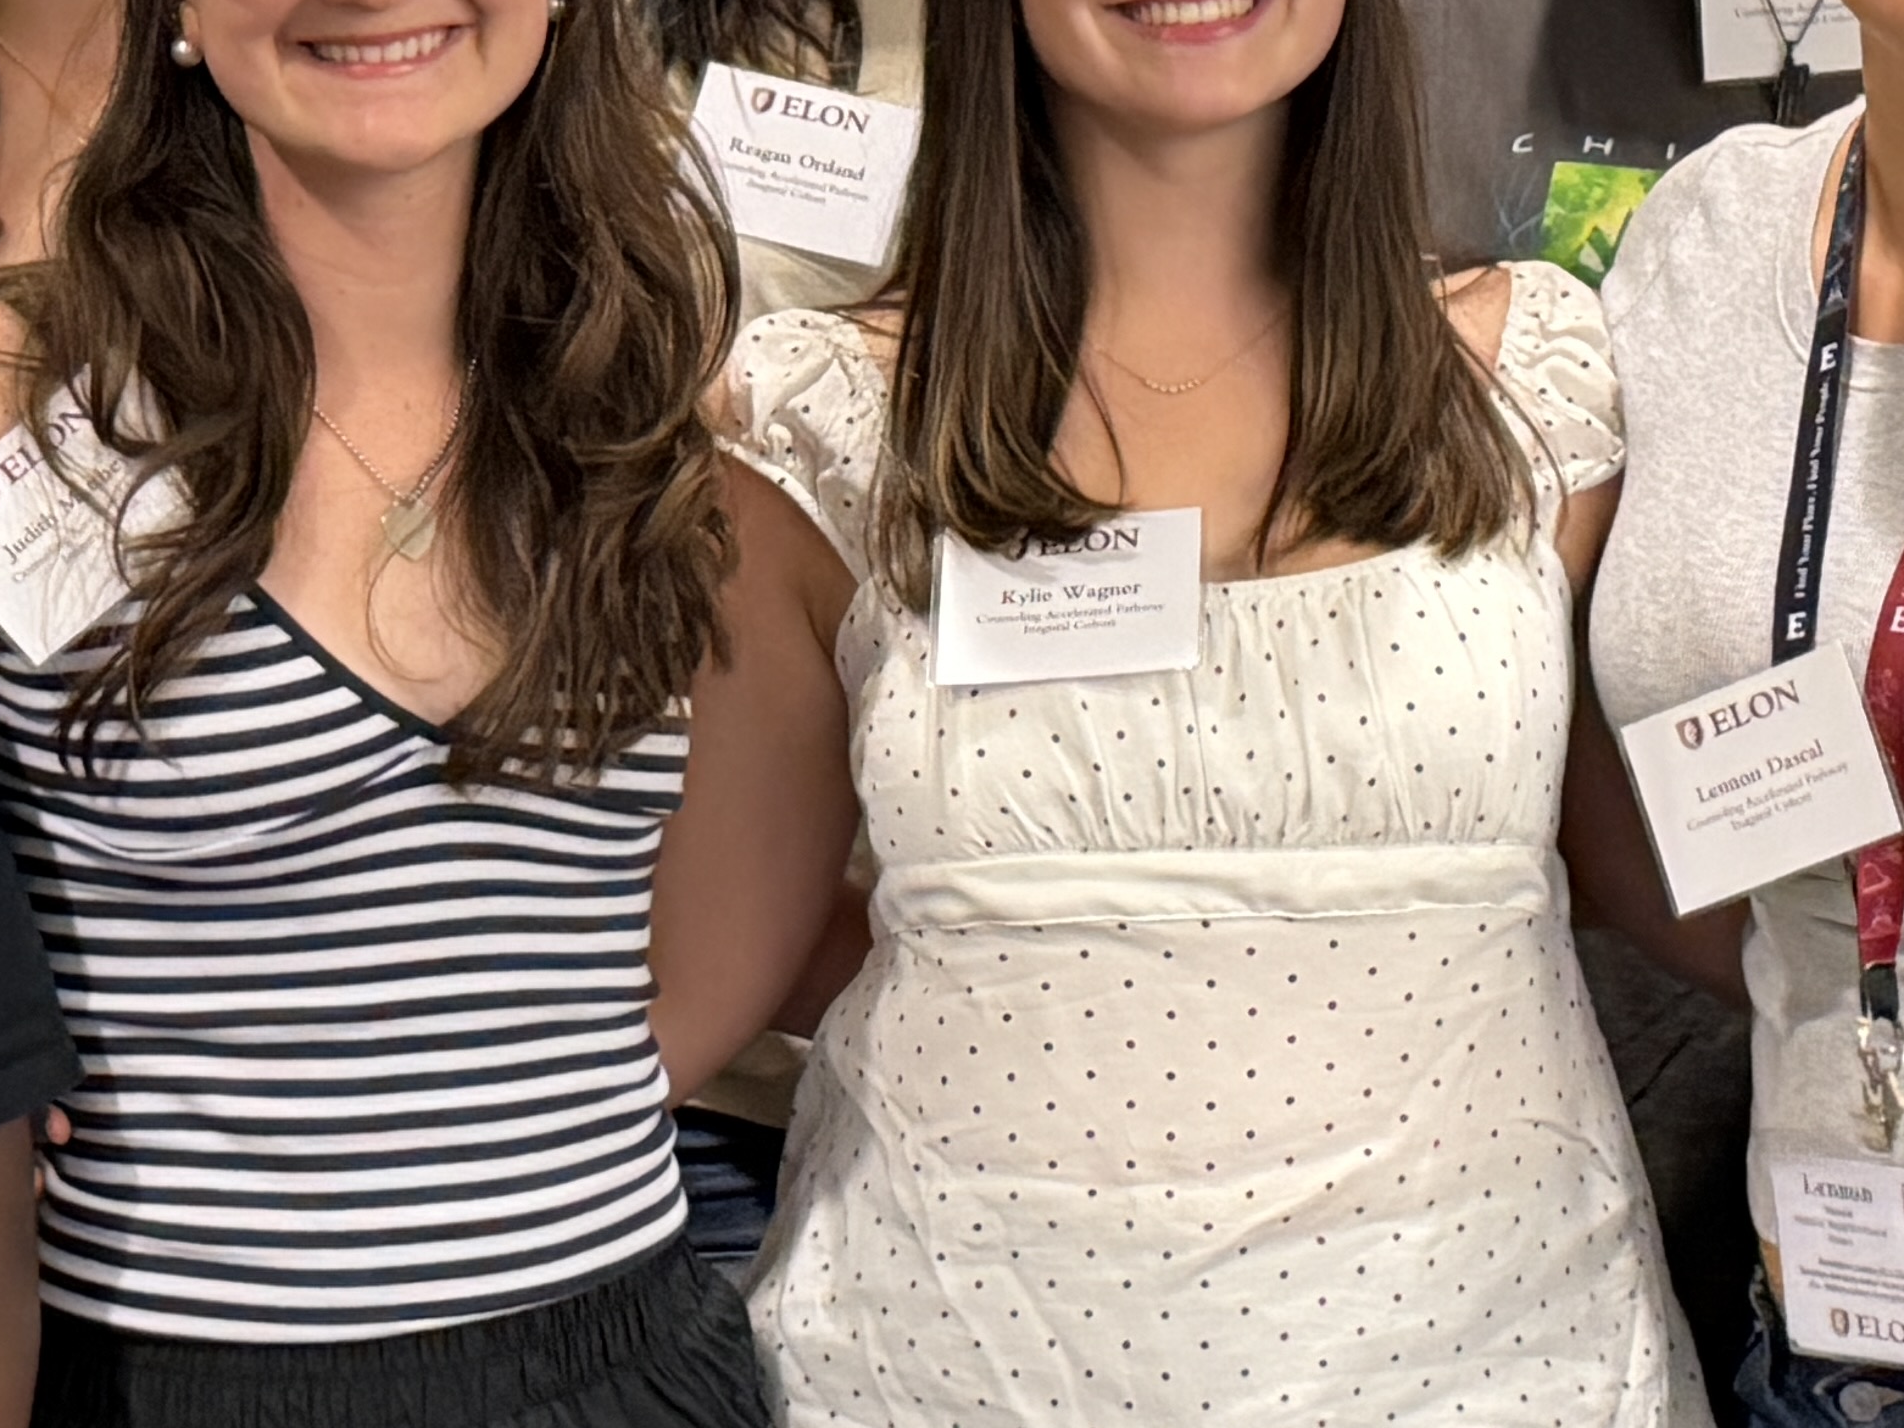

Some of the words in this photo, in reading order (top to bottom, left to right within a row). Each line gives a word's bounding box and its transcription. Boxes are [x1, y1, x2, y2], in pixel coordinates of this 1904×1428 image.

[780, 94, 872, 135] ELON
[728, 135, 792, 165] Reagan
[1819, 341, 1839, 372] E
[1, 512, 59, 565] Judith
[1039, 526, 1141, 558] ELON
[1000, 588, 1053, 607] Kylie
[1063, 581, 1143, 603] Wagner
[1785, 611, 1808, 641] E
[1708, 678, 1802, 738] ELON
[1695, 767, 1763, 804] Lennon
[1766, 738, 1826, 777] Dascal
